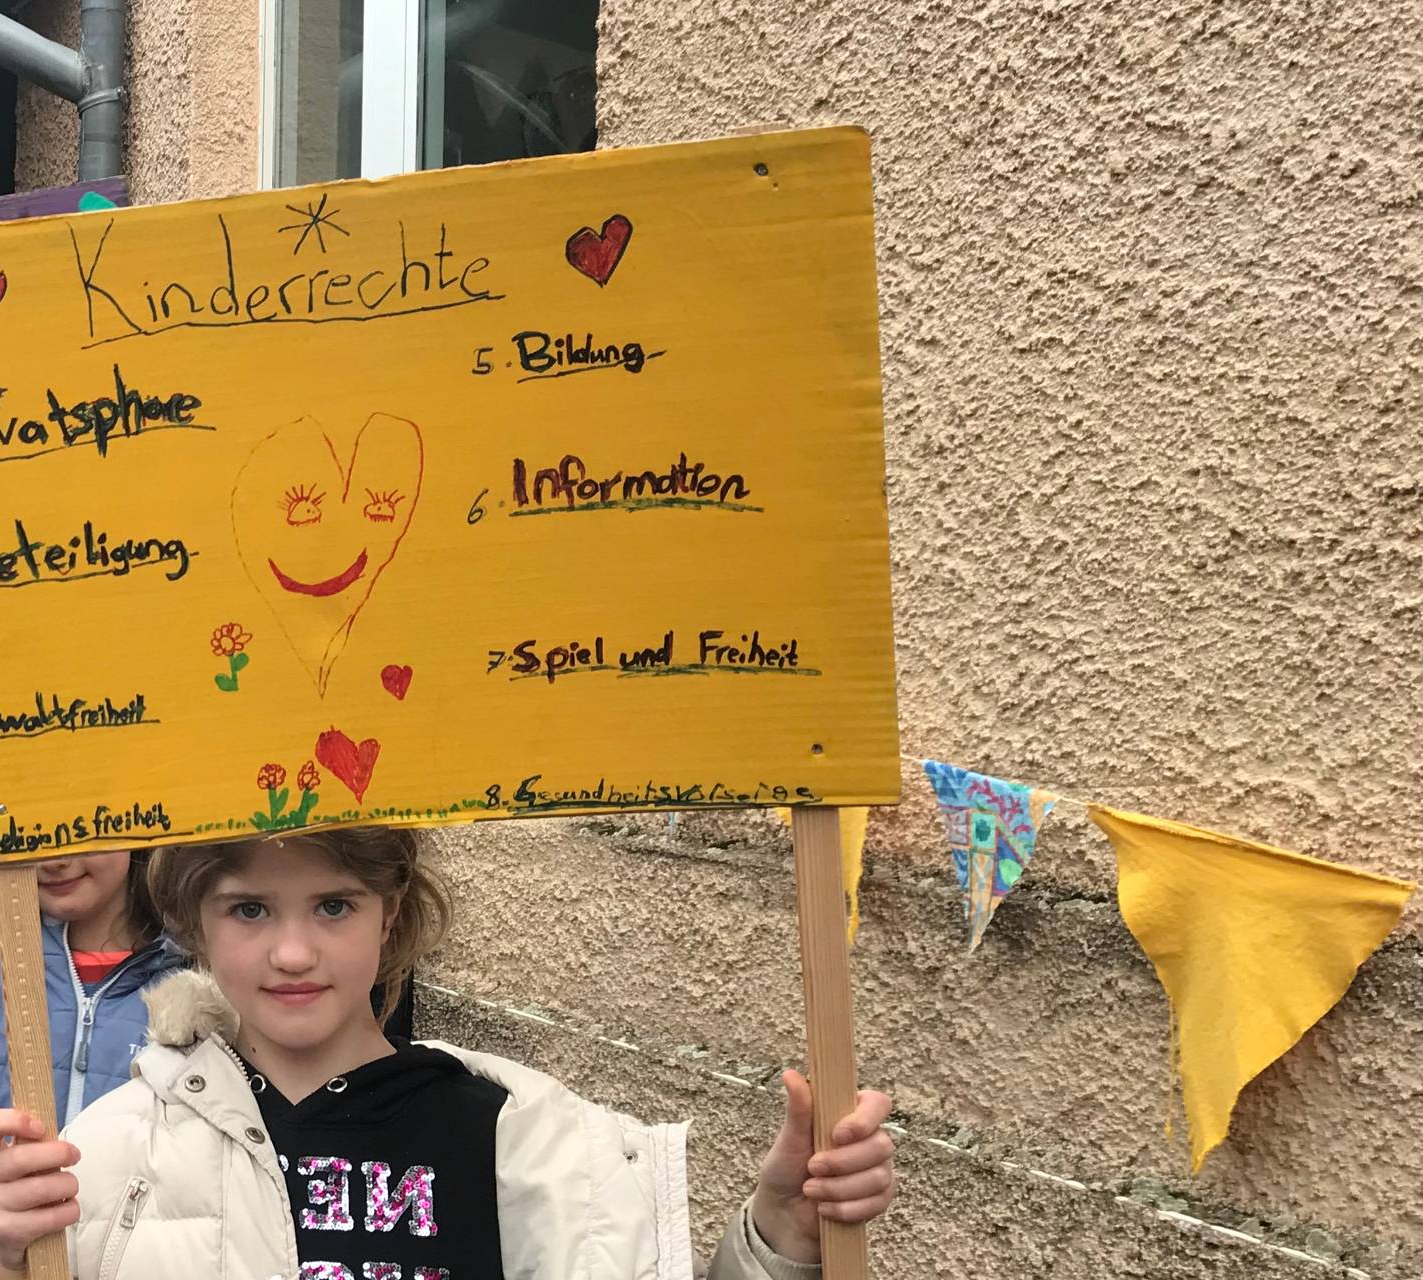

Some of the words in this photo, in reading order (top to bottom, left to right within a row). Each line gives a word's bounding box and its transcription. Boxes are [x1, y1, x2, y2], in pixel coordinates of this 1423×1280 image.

[67, 214, 492, 336] Kinderrechte
[472, 346, 513, 376] 5.
[511, 330, 646, 374] Bildung
[466, 487, 506, 526] 6.
[512, 451, 751, 507] Information
[485, 650, 514, 675] 7.
[512, 636, 605, 685] Spiel
[618, 629, 674, 668] und
[699, 630, 799, 668] Freiheit
[485, 783, 510, 810] 8.
